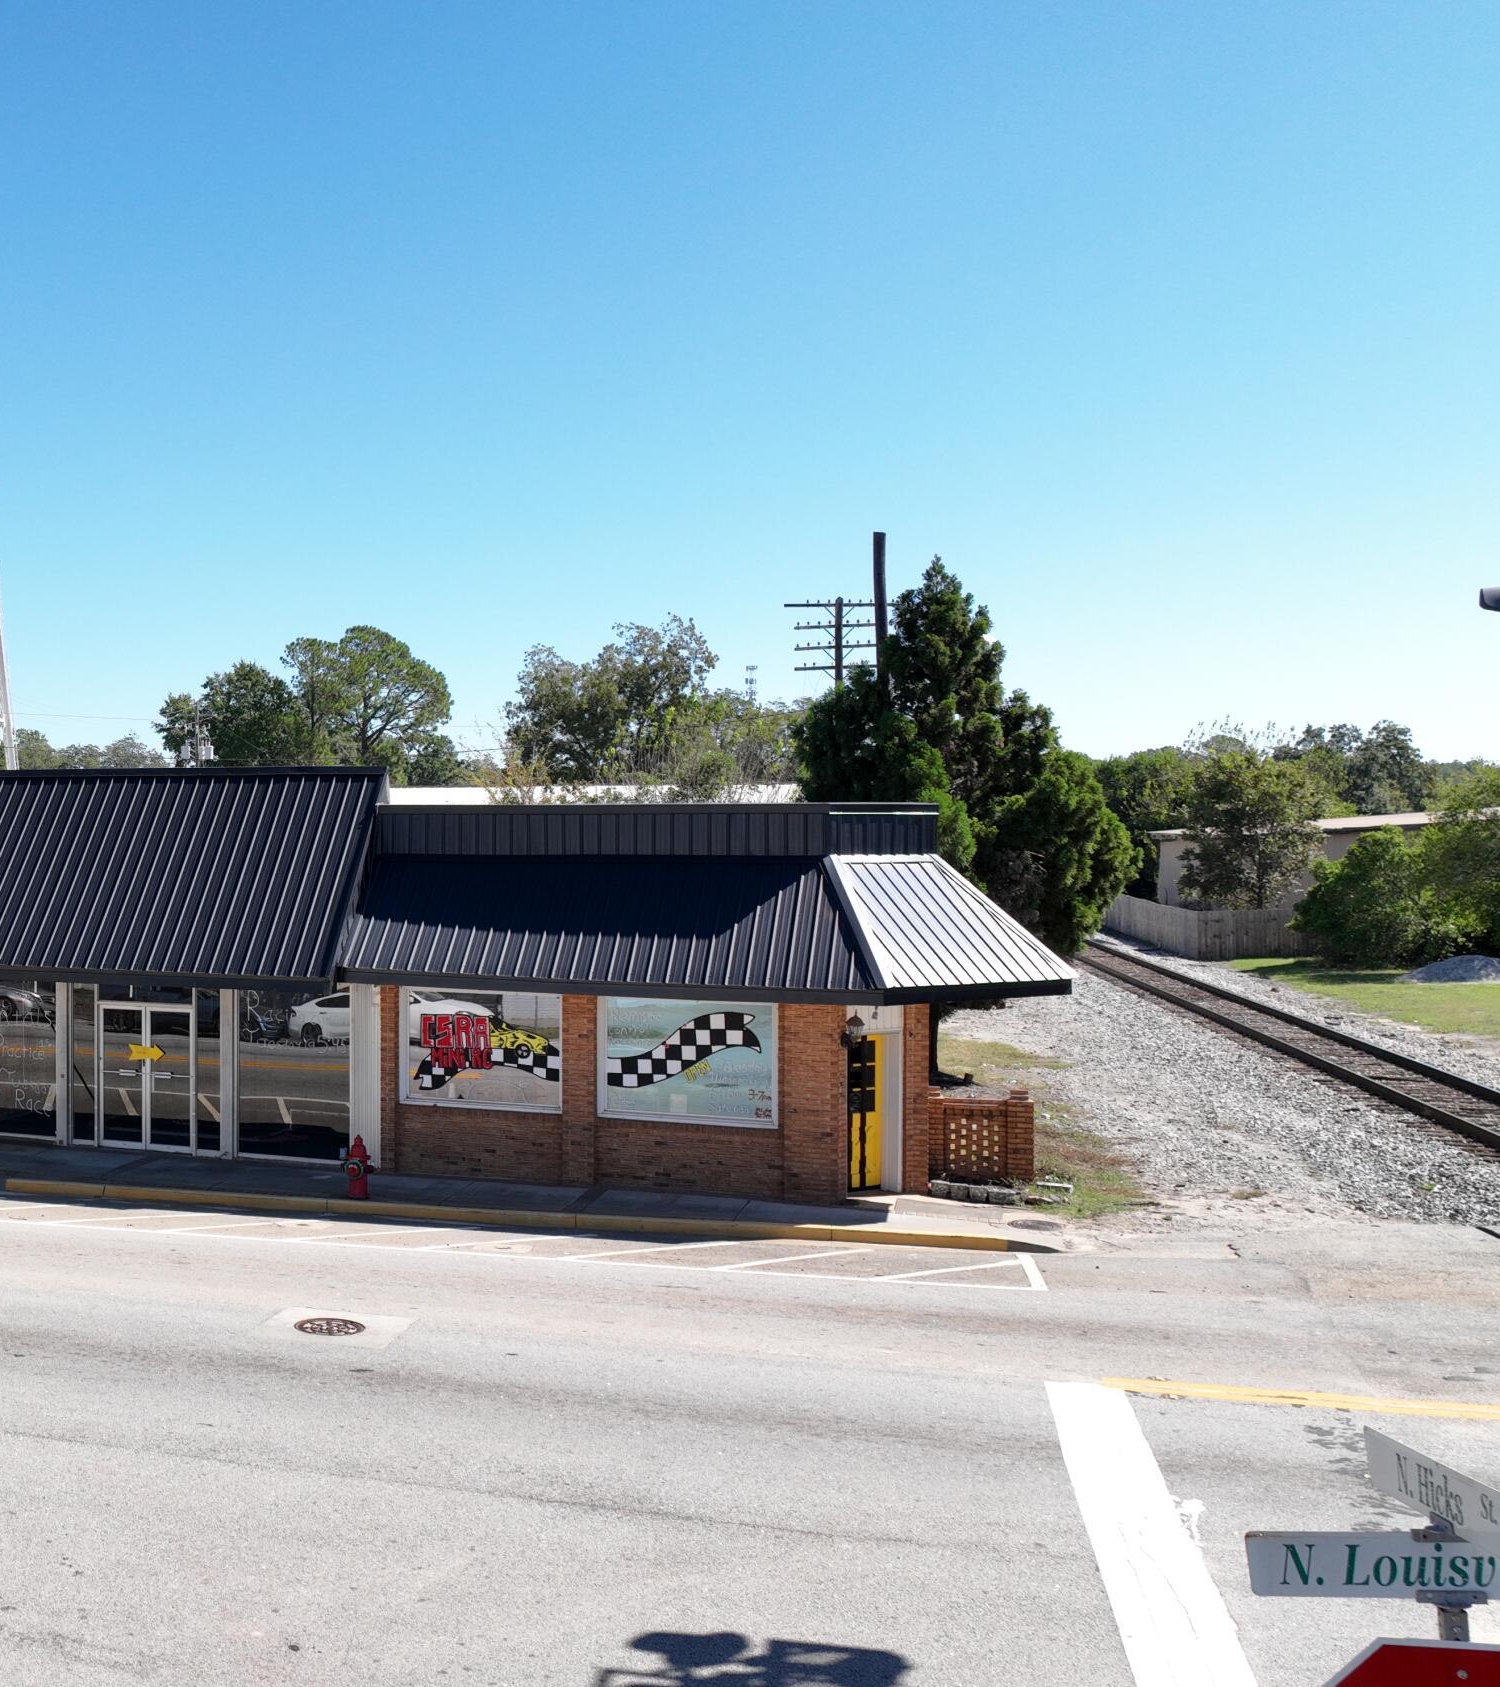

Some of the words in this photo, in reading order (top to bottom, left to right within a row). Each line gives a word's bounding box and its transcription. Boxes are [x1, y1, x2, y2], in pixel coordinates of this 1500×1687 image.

[420, 1013, 492, 1049] CSRA
[470, 1048, 494, 1070] RC
[683, 1059, 712, 1084] OPEN
[14, 1088, 51, 1118] Race
[1395, 1452, 1414, 1499] N.
[1416, 1462, 1465, 1527] Hicks
[1480, 1492, 1499, 1525] St.
[1280, 1543, 1324, 1586] N.
[1342, 1542, 1496, 1588] Louisv
